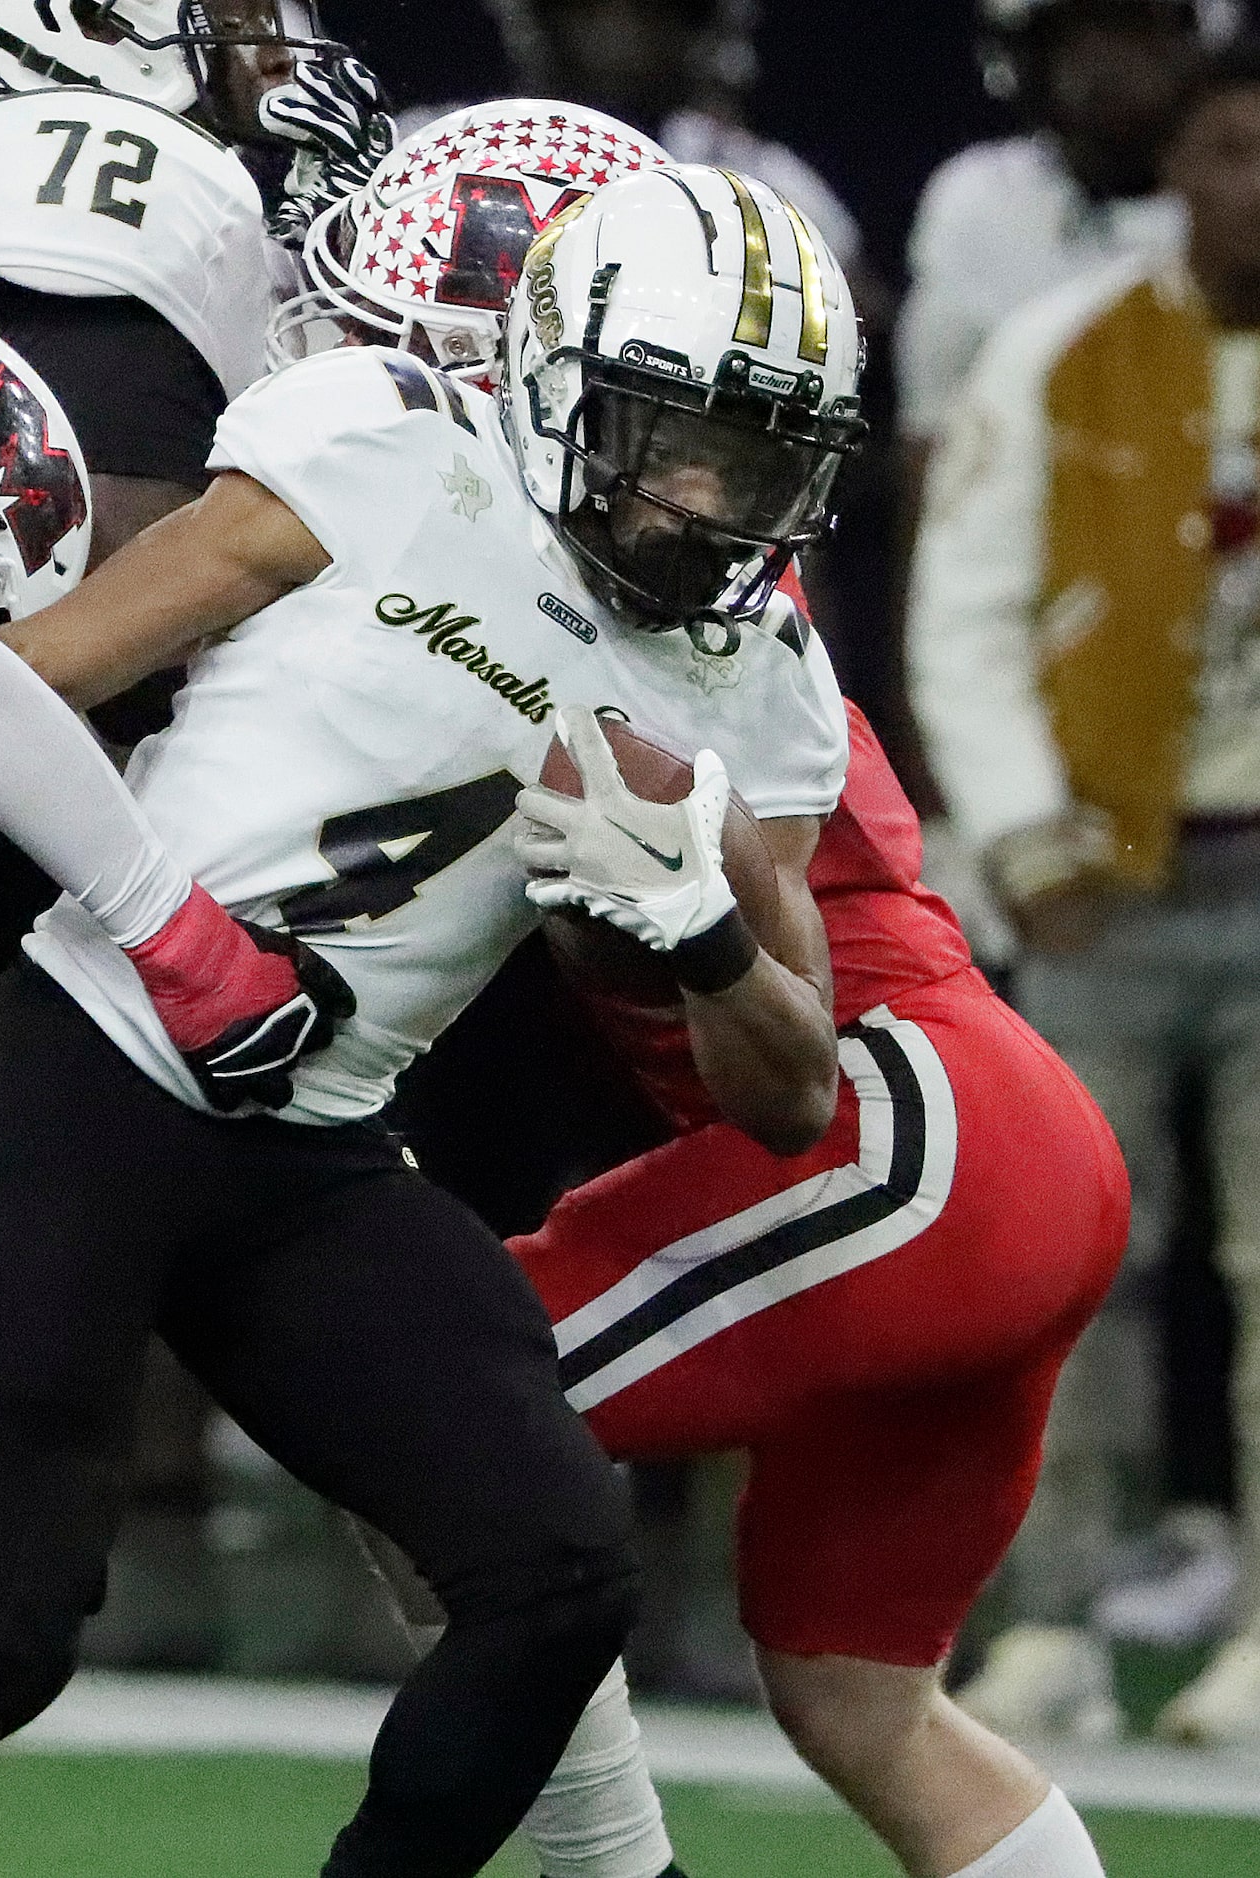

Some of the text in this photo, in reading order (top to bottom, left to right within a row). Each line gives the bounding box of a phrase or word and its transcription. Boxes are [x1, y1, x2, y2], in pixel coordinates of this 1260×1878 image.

[35, 119, 160, 230] 72
[645, 355, 689, 378] SPORTS
[375, 592, 555, 725] Marsalis
[541, 595, 595, 642] BATTLE
[278, 766, 524, 936] 4
